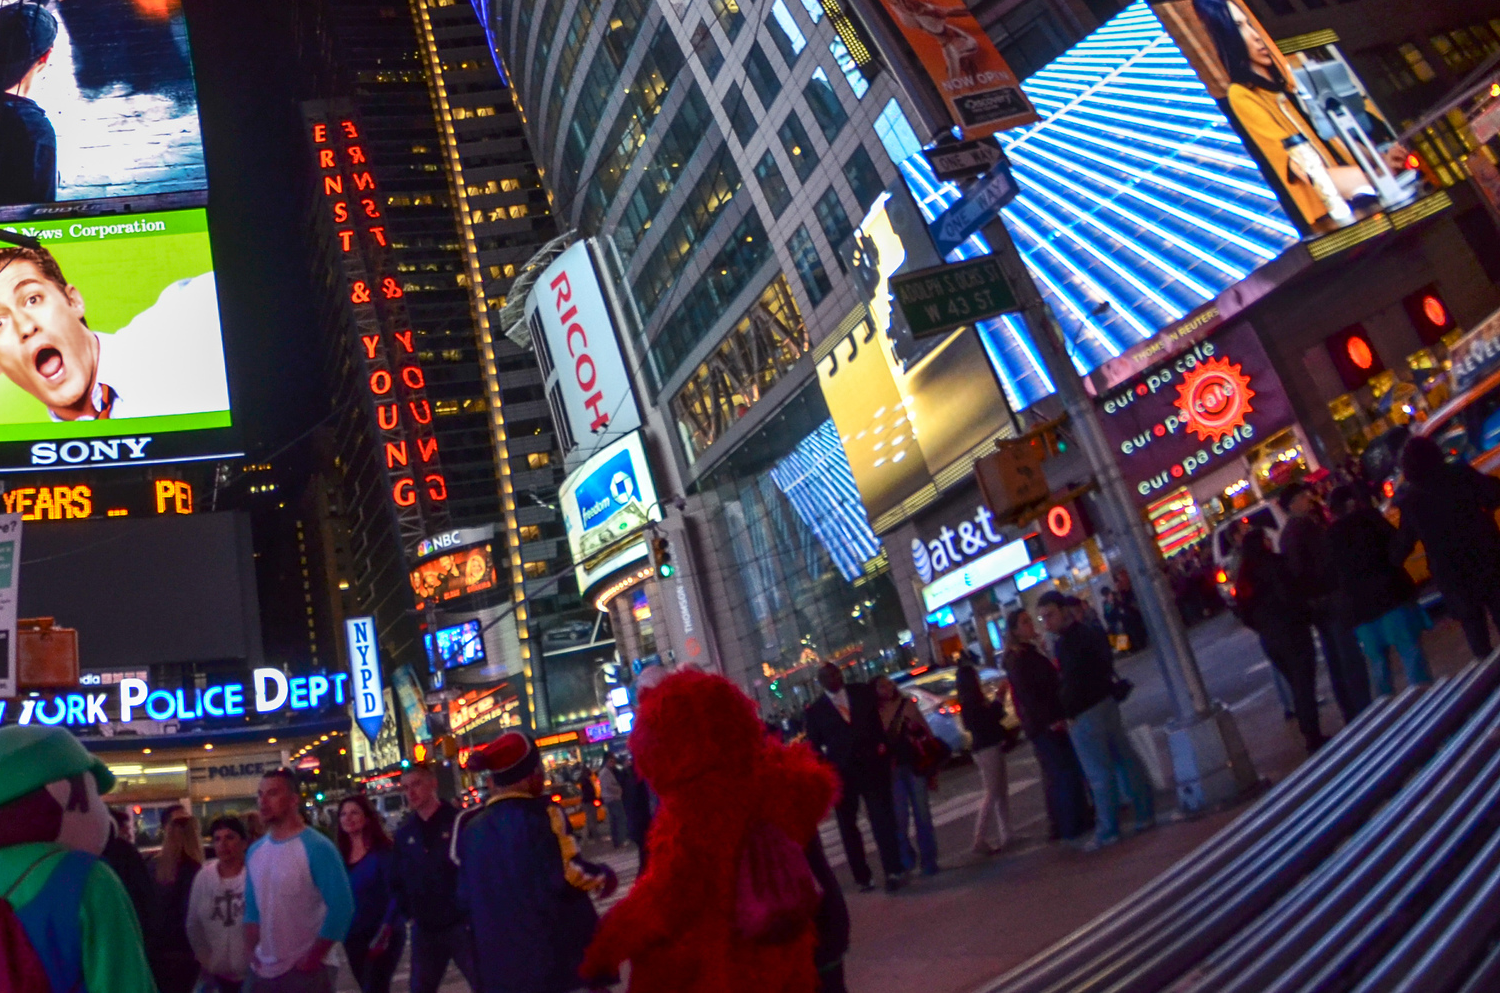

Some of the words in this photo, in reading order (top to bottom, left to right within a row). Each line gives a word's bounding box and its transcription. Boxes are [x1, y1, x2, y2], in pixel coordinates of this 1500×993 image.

[941, 75, 975, 91] NOW
[940, 155, 963, 169] ONE
[975, 149, 995, 164] WAY
[945, 213, 968, 239] ONE
[978, 176, 1006, 210] WAY
[69, 219, 166, 239] Corporation
[313, 123, 354, 252] ERNST
[351, 281, 370, 304] &
[362, 334, 416, 507] YOUNG
[925, 305, 943, 323] W
[948, 295, 971, 317] 43
[974, 289, 996, 309] ST
[549, 270, 610, 434] RICOH
[1133, 333, 1179, 363] THOMSN
[1177, 308, 1220, 337] REUTERS
[1104, 369, 1172, 413] europa
[30, 437, 152, 465] SONY
[1138, 450, 1208, 495] europa
[3, 485, 92, 520] YEARS
[581, 496, 611, 531] freedom
[432, 530, 460, 550] NBC
[928, 506, 1002, 572] at&t
[675, 585, 693, 634] THOMSON
[79, 673, 100, 685] dia
[353, 622, 377, 714] NYPD
[208, 762, 265, 778] POLICE
